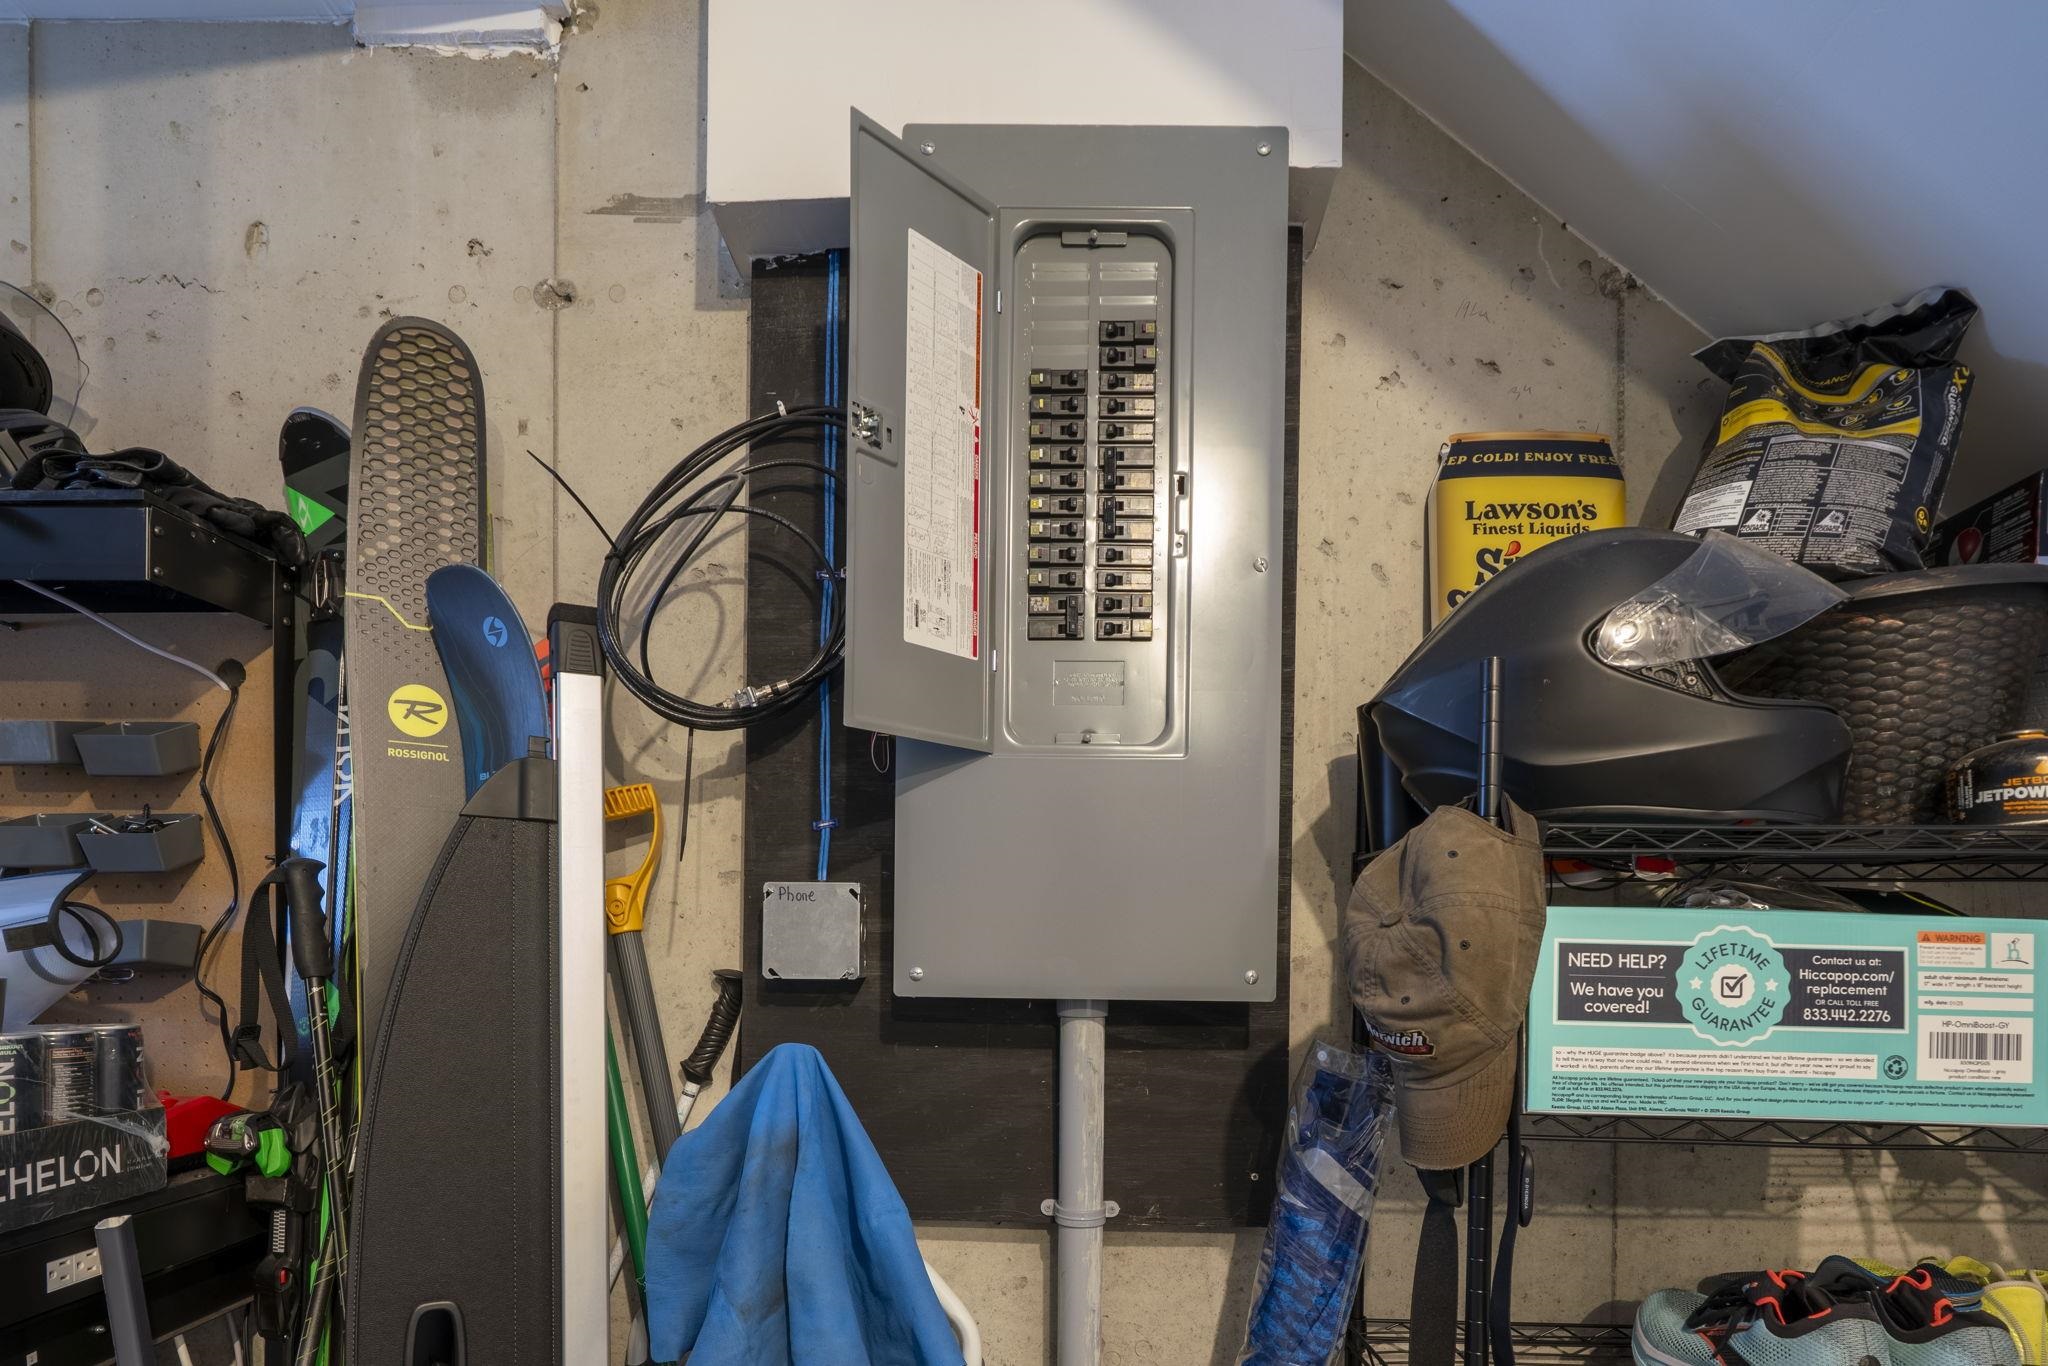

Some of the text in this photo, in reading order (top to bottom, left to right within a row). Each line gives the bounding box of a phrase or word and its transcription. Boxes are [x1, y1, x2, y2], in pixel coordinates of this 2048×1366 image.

[1472, 452, 1519, 463] COLD!
[1524, 452, 1574, 462] ENJOY
[1465, 500, 1598, 521] Lawson's
[1472, 522, 1590, 537] Finest Liquids
[387, 747, 449, 762] ROSSIGNOL
[1975, 786, 2048, 803] JETPOW
[778, 886, 816, 902] Phone
[1936, 934, 1981, 943] WARNING
[1568, 952, 1667, 969] NEED HELP?
[1695, 942, 1770, 971] LIFETIME
[1812, 955, 1852, 965] Contact
[1799, 969, 1895, 984] Hiccapop.com/
[1570, 982, 1664, 1001] We have you
[1807, 984, 1887, 997] replacement
[1584, 1000, 1650, 1014] covered!
[1692, 996, 1776, 1032] GUARANTEE
[1803, 1008, 1891, 1022] 833.442.2276
[0, 1144, 122, 1202] HELON
